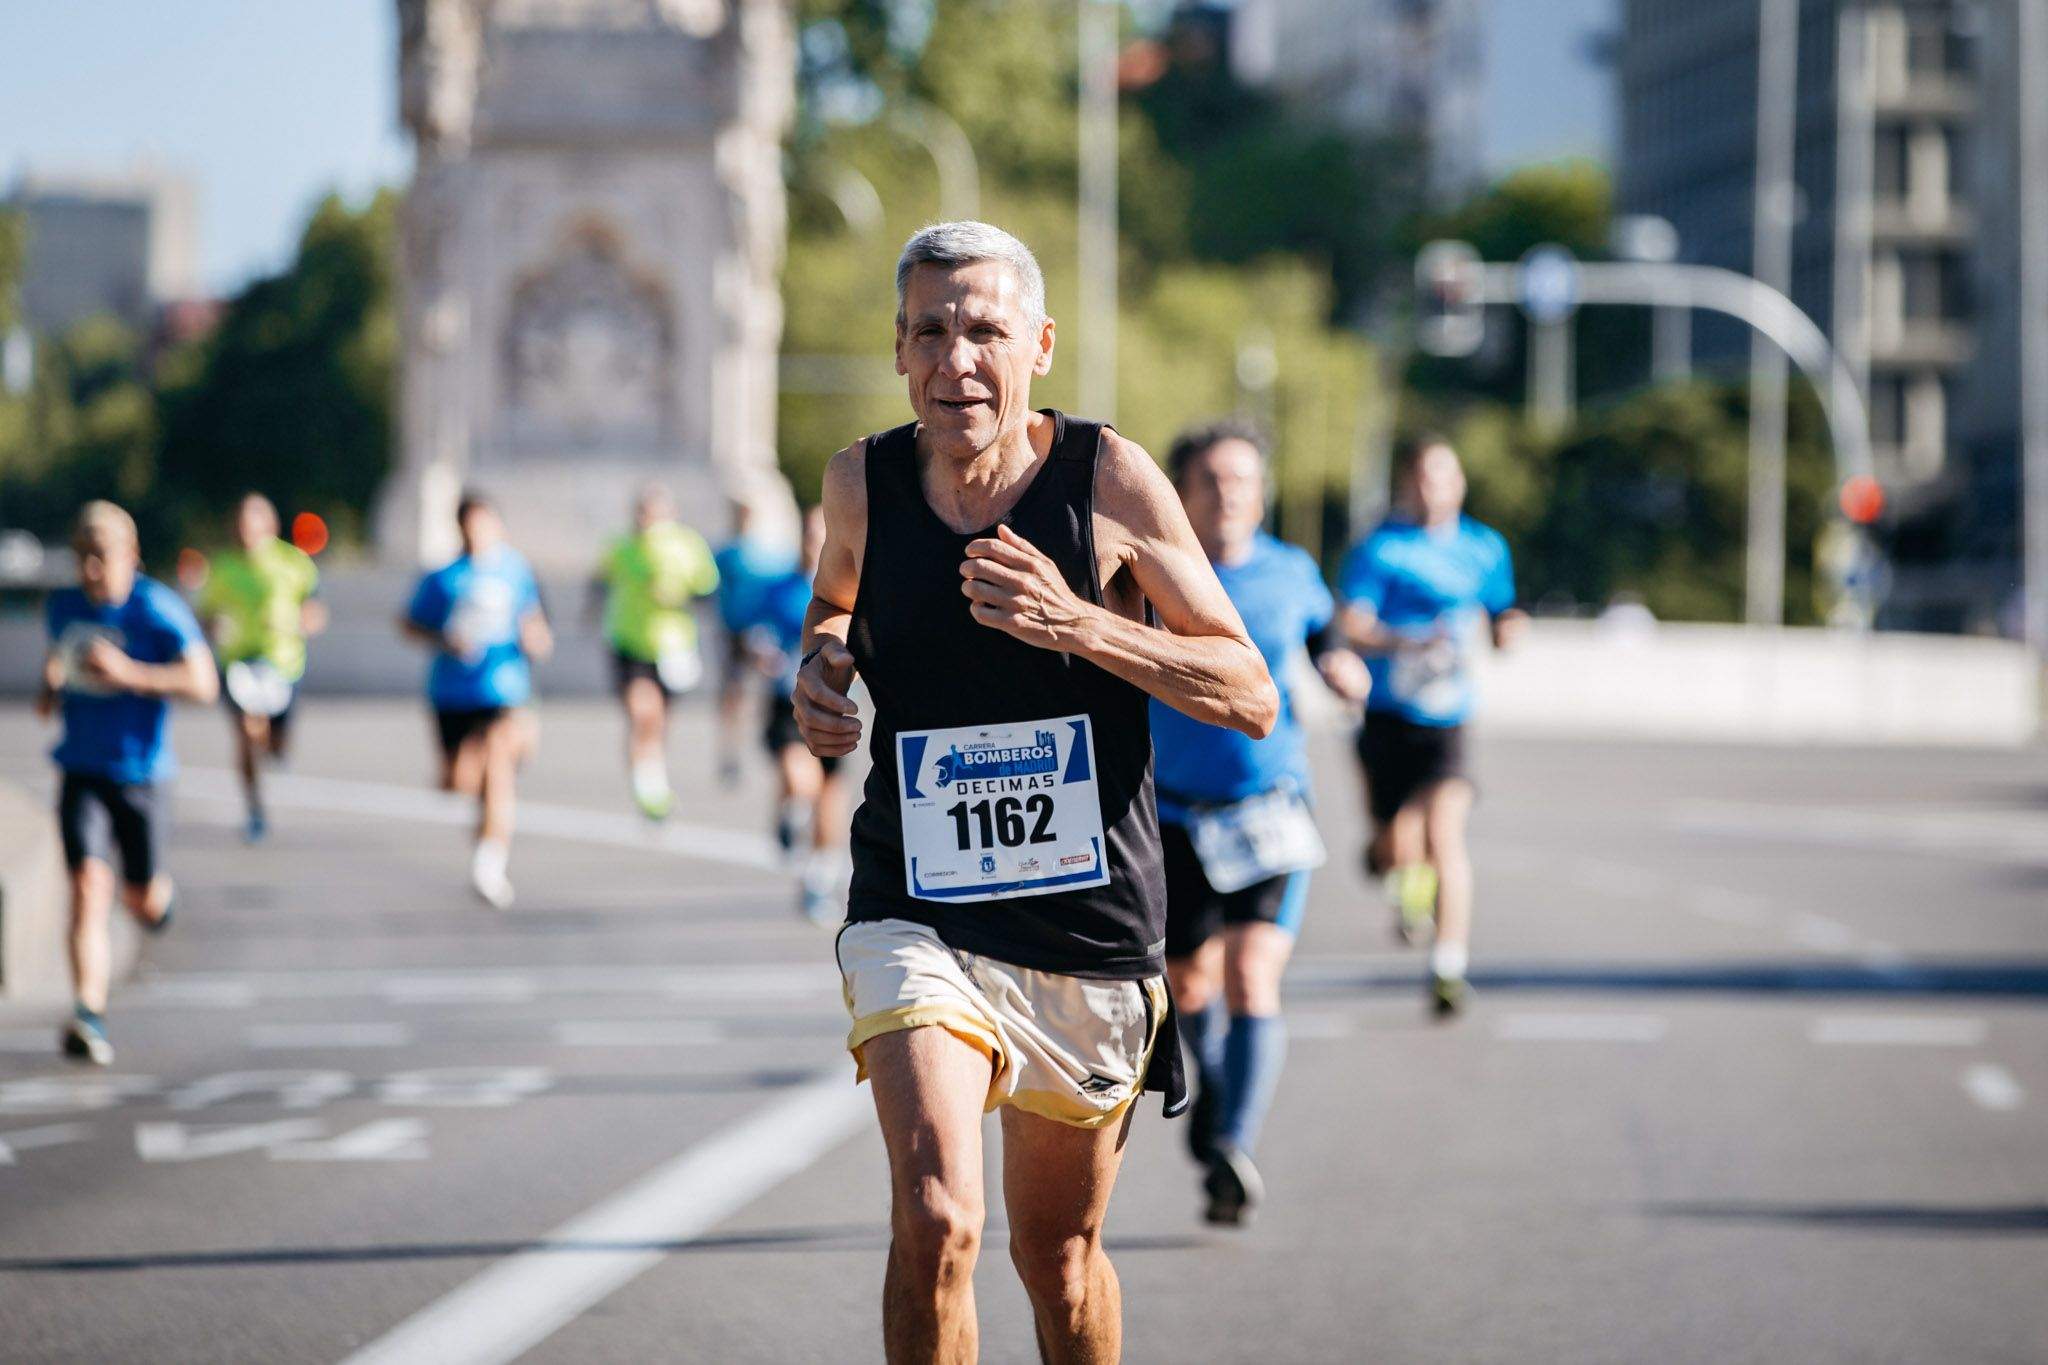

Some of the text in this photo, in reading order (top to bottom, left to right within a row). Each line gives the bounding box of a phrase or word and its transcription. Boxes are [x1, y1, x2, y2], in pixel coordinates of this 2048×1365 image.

[963, 742, 996, 751] CARRERA
[963, 745, 1054, 765] BOMBEROS
[1014, 757, 1055, 772] MADRID
[957, 774, 1055, 796] DECIMAS
[946, 793, 1058, 851] 1162
